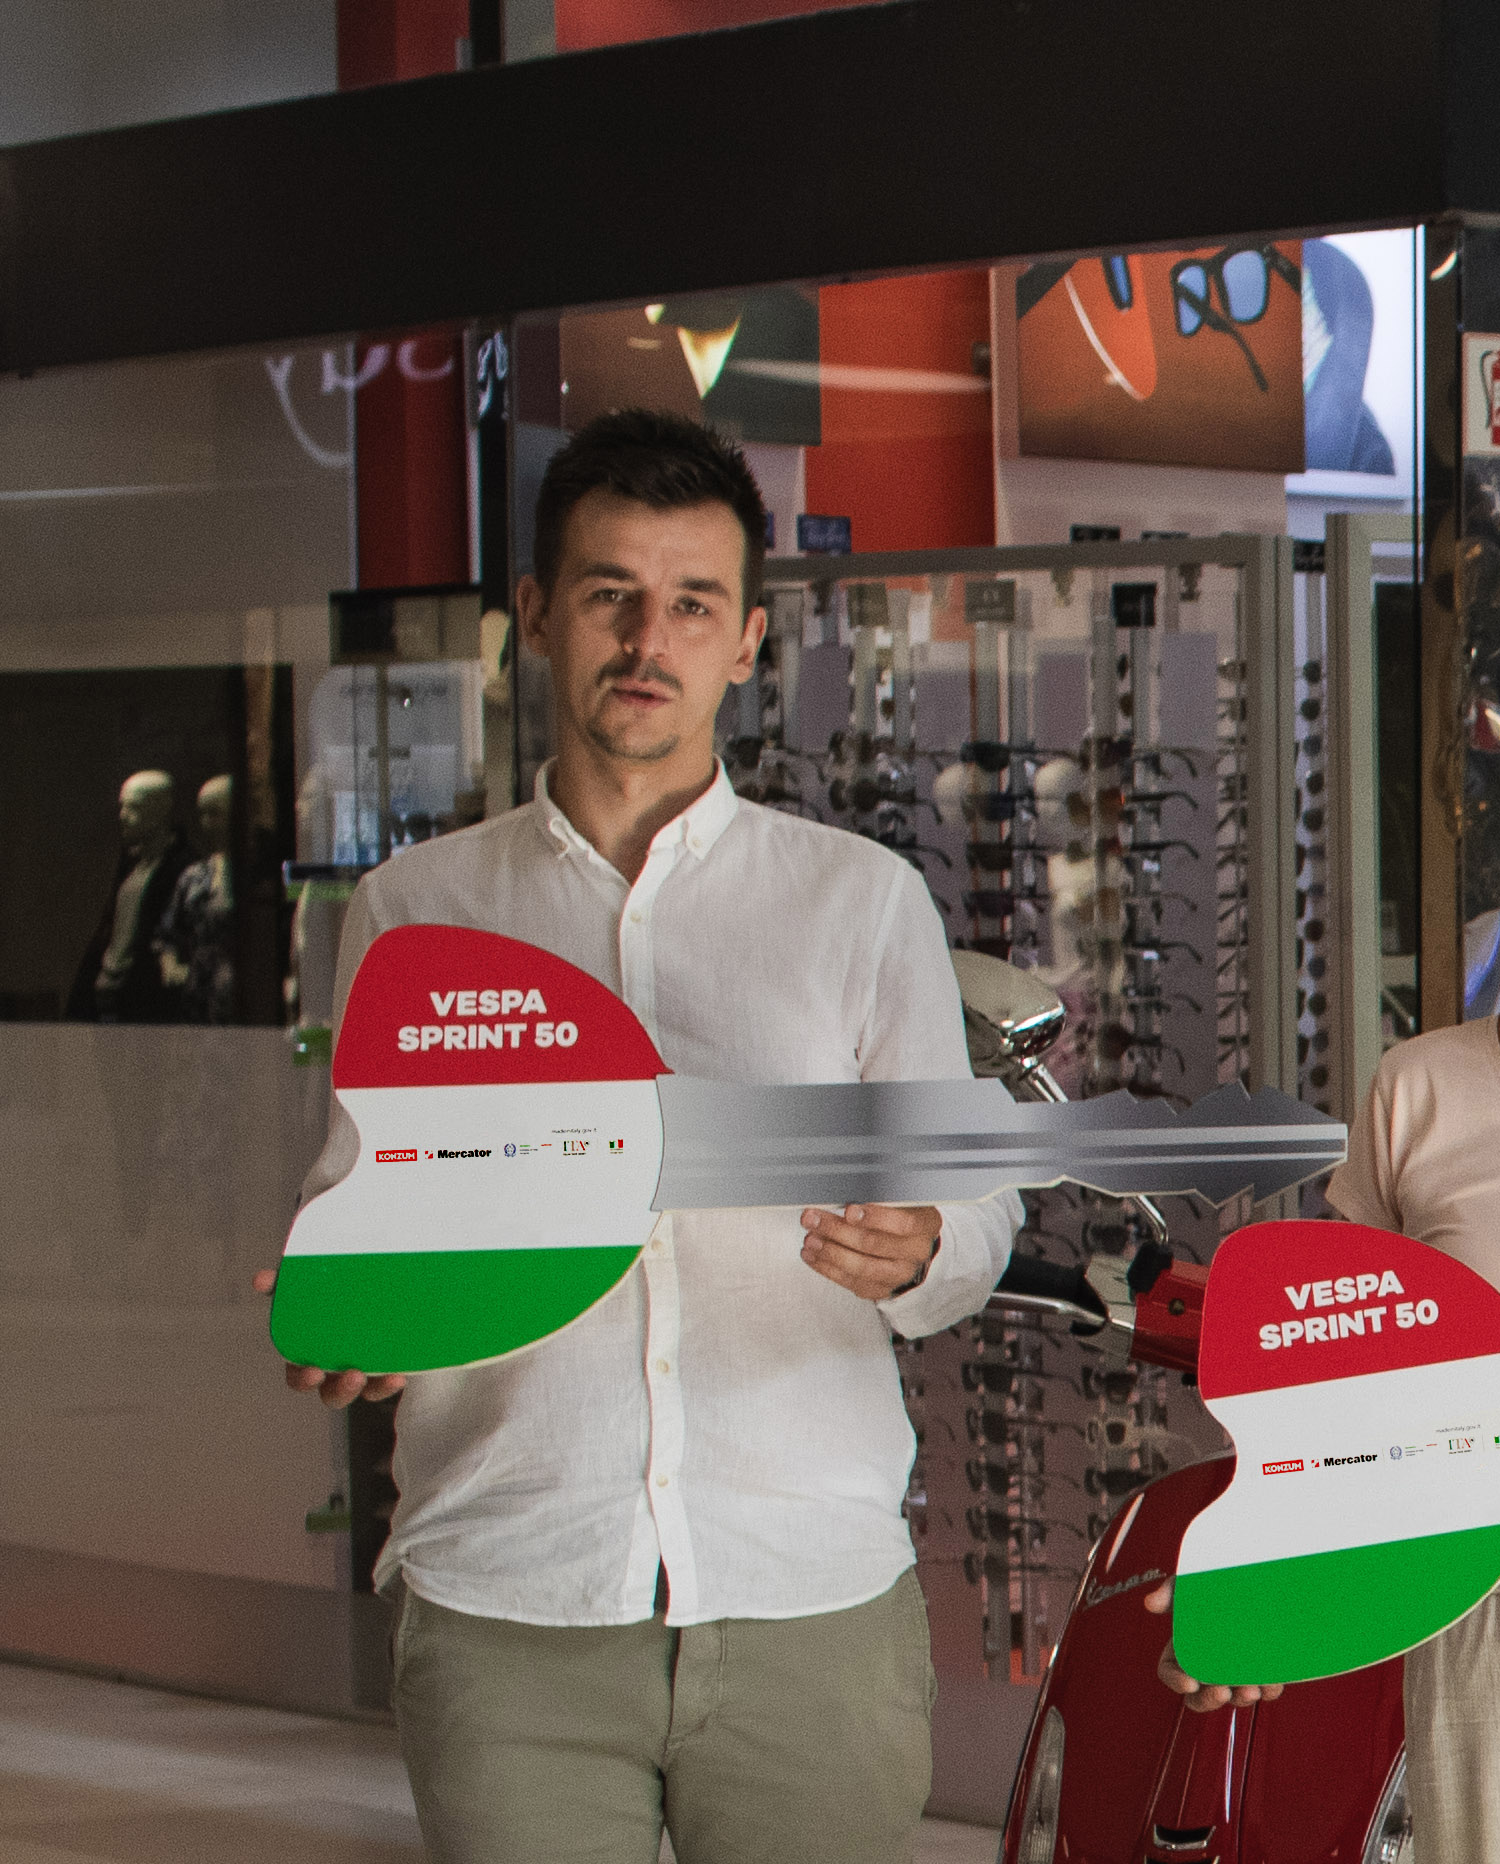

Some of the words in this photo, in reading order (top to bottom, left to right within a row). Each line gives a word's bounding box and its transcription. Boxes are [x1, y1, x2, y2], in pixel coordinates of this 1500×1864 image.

[430, 988, 548, 1017] VESPA
[397, 1022, 528, 1052] SPRINT
[534, 1021, 579, 1048] 50
[377, 1150, 416, 1162] KONZUM
[437, 1148, 492, 1160] Mercator
[1285, 1270, 1405, 1311] VESPA
[1258, 1306, 1388, 1350] SPRINT
[1395, 1298, 1439, 1329] 50
[1264, 1461, 1303, 1475] KONZUM
[1323, 1453, 1378, 1467] Mercator
